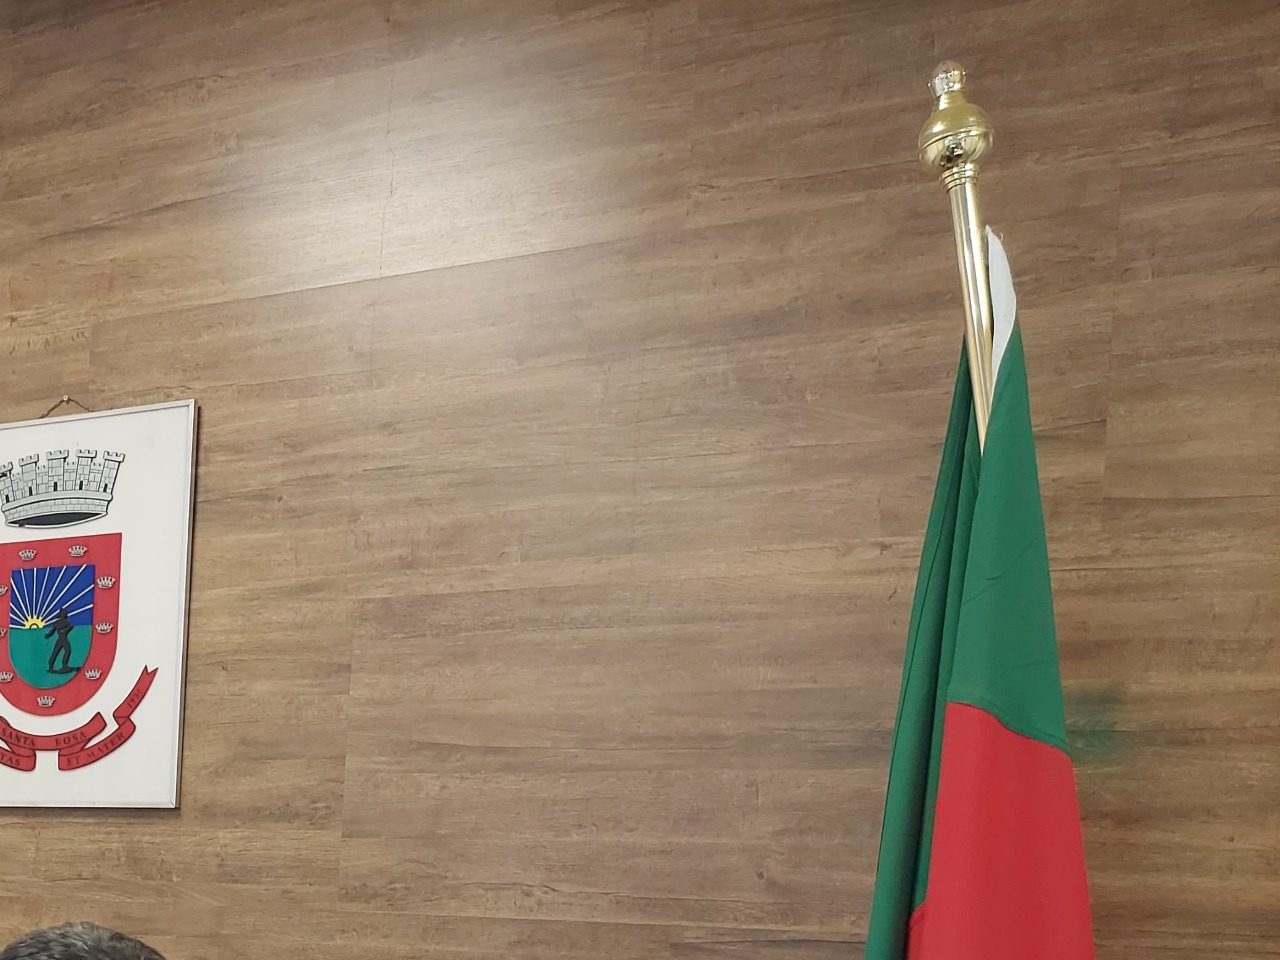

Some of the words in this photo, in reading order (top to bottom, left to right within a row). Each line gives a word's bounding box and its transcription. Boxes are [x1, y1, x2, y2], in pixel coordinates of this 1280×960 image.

[0, 727, 35, 748] SANTA
[55, 731, 87, 747] ROSA
[67, 756, 80, 767] ET
